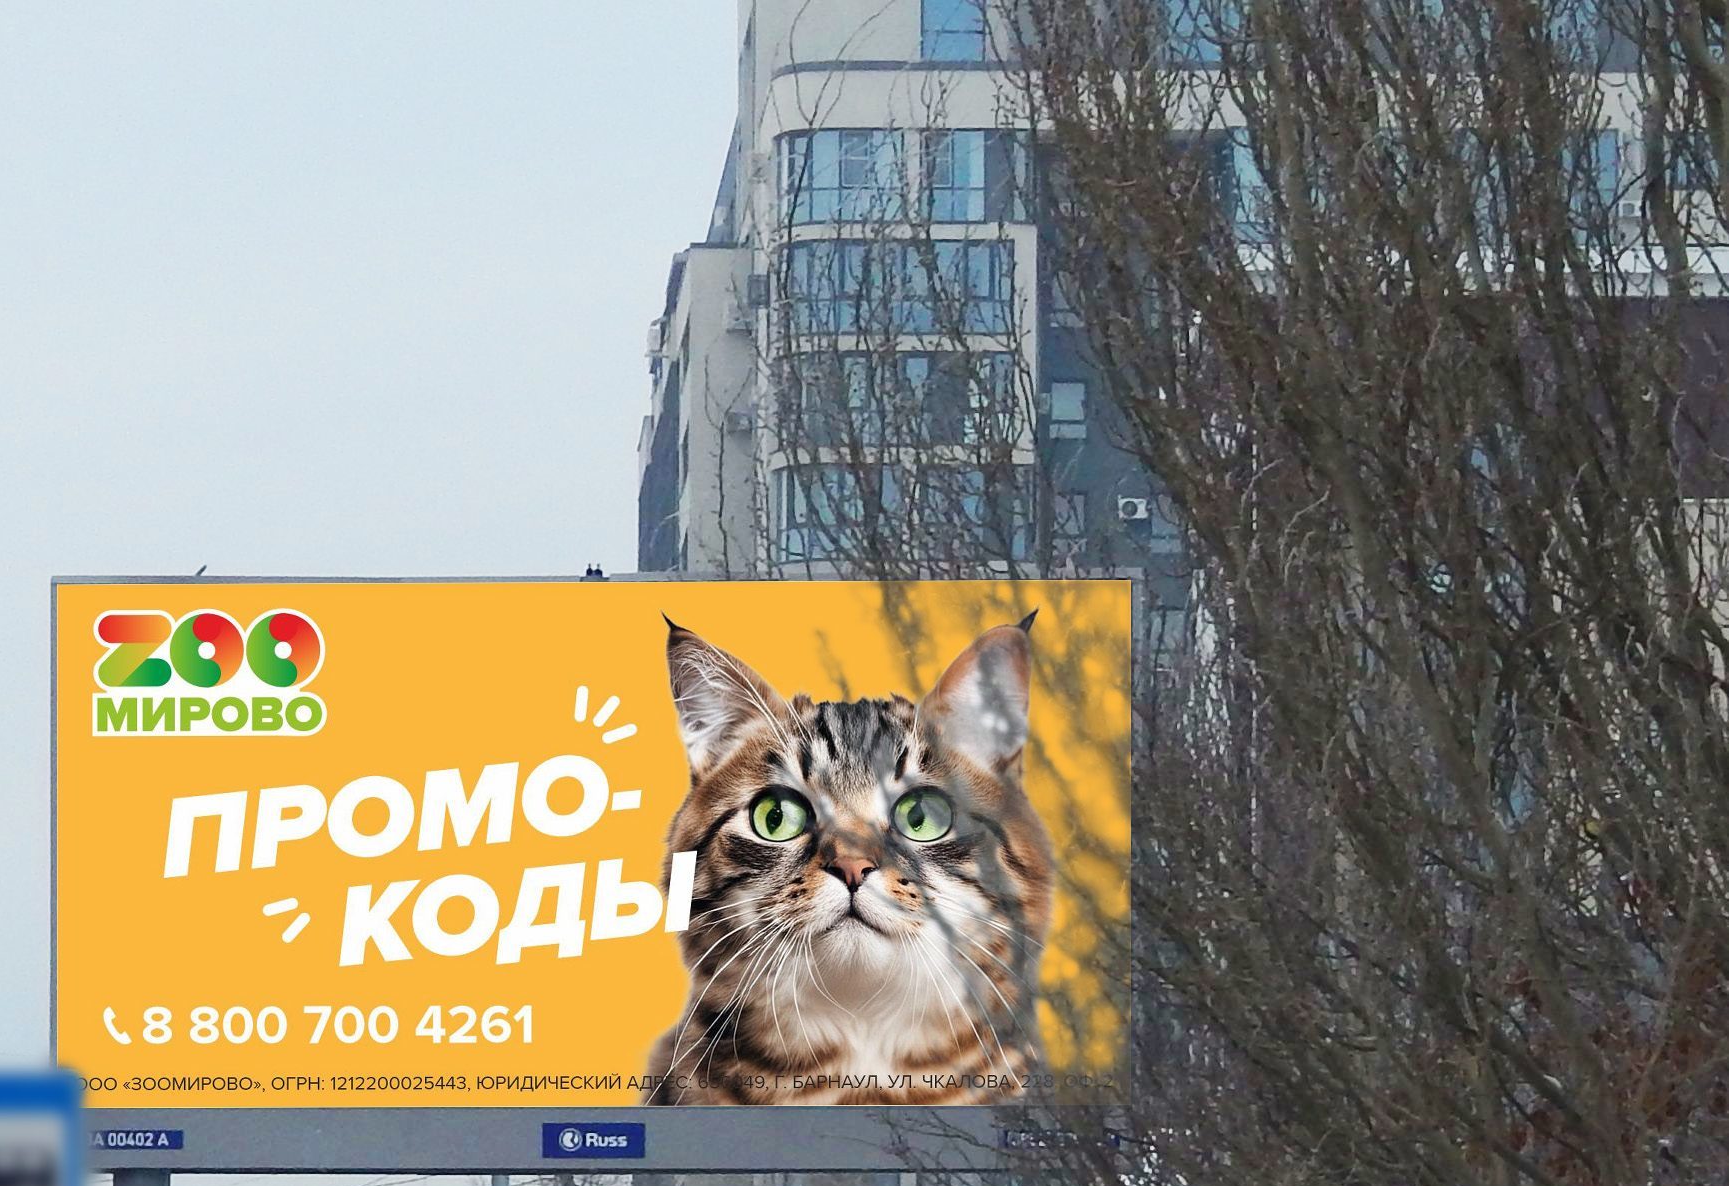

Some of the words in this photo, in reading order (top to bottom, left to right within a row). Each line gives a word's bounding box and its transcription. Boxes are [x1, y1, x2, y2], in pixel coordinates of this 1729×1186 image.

[96, 696, 323, 732] МИРОВО
[163, 754, 643, 879] ПРОМО-
[338, 850, 698, 967] КОДЫ
[142, 1005, 173, 1044] 8
[188, 1005, 288, 1044] 800
[302, 1005, 399, 1044] 700
[415, 1004, 534, 1044] 4261
[122, 1076, 266, 1093] «ЗООМИРОВО»,
[270, 1076, 325, 1091] ОГРН:
[331, 1075, 471, 1093] 1212200025443,
[476, 1073, 622, 1093] ЮРИДИЧЕСКИЙ
[792, 1074, 883, 1092] БАРНАУЛ,
[887, 1074, 917, 1090] УЛ.
[107, 1132, 154, 1147] 00402
[157, 1132, 170, 1147] А
[585, 1132, 628, 1148] Russ
